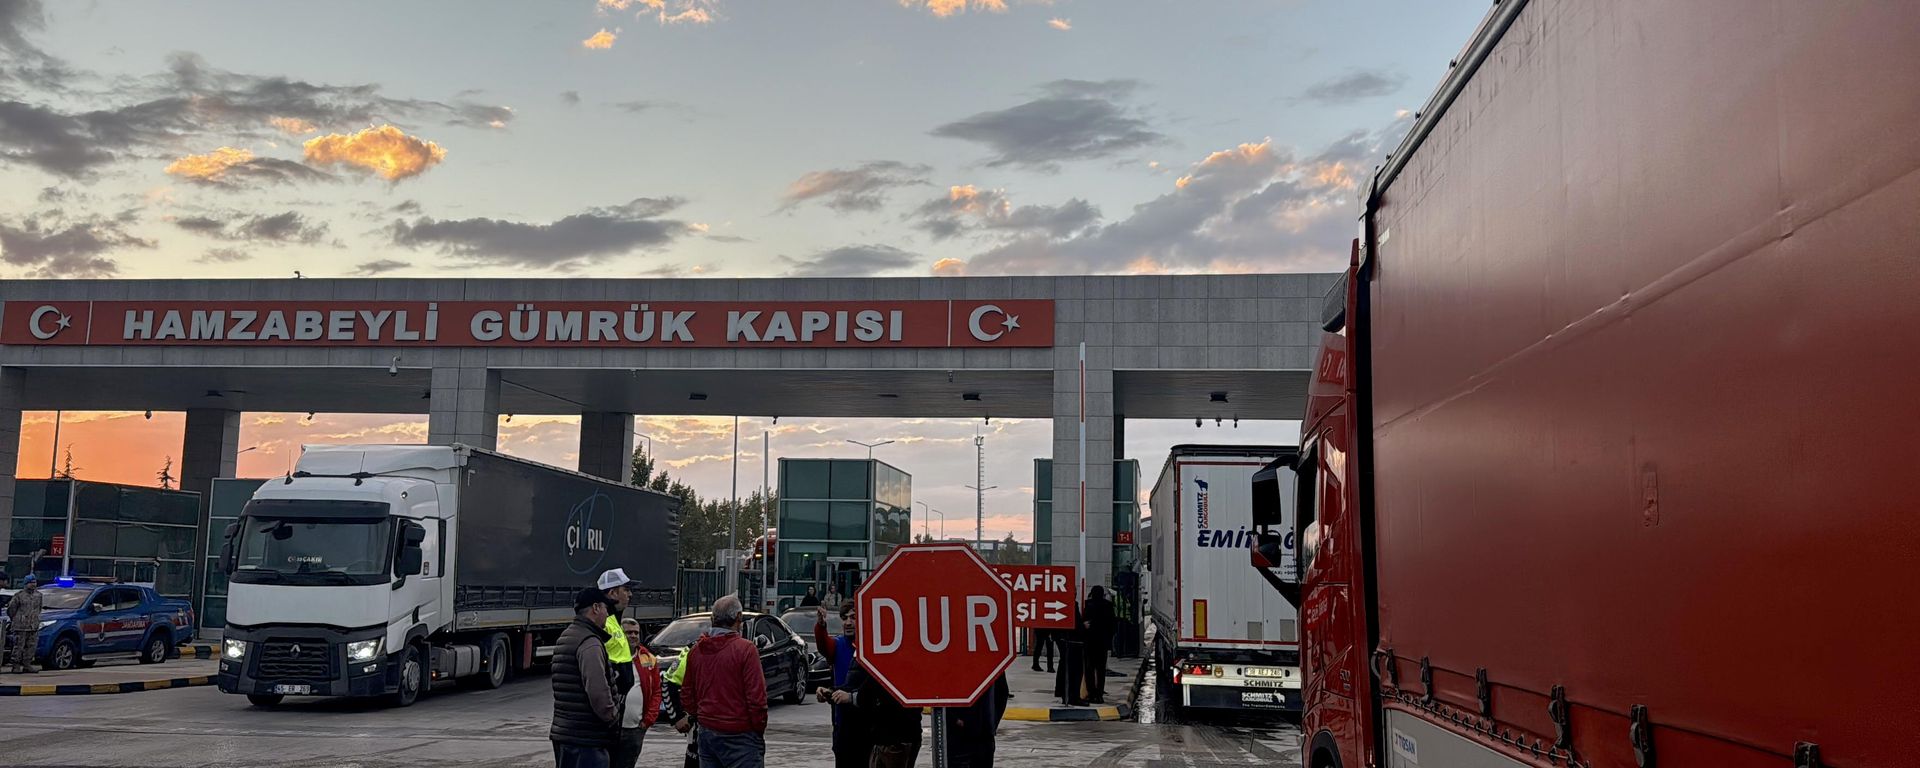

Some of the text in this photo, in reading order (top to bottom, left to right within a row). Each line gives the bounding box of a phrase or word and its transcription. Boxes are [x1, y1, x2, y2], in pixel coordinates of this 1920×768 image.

[123, 303, 903, 342] HAMZABEYLİ GÜMRÜK KAPISI
[1001, 569, 1067, 593] SAFİR
[1016, 598, 1037, 622] Şİ
[871, 595, 999, 654] DUR
[1243, 680, 1283, 688] SCHMITZ
